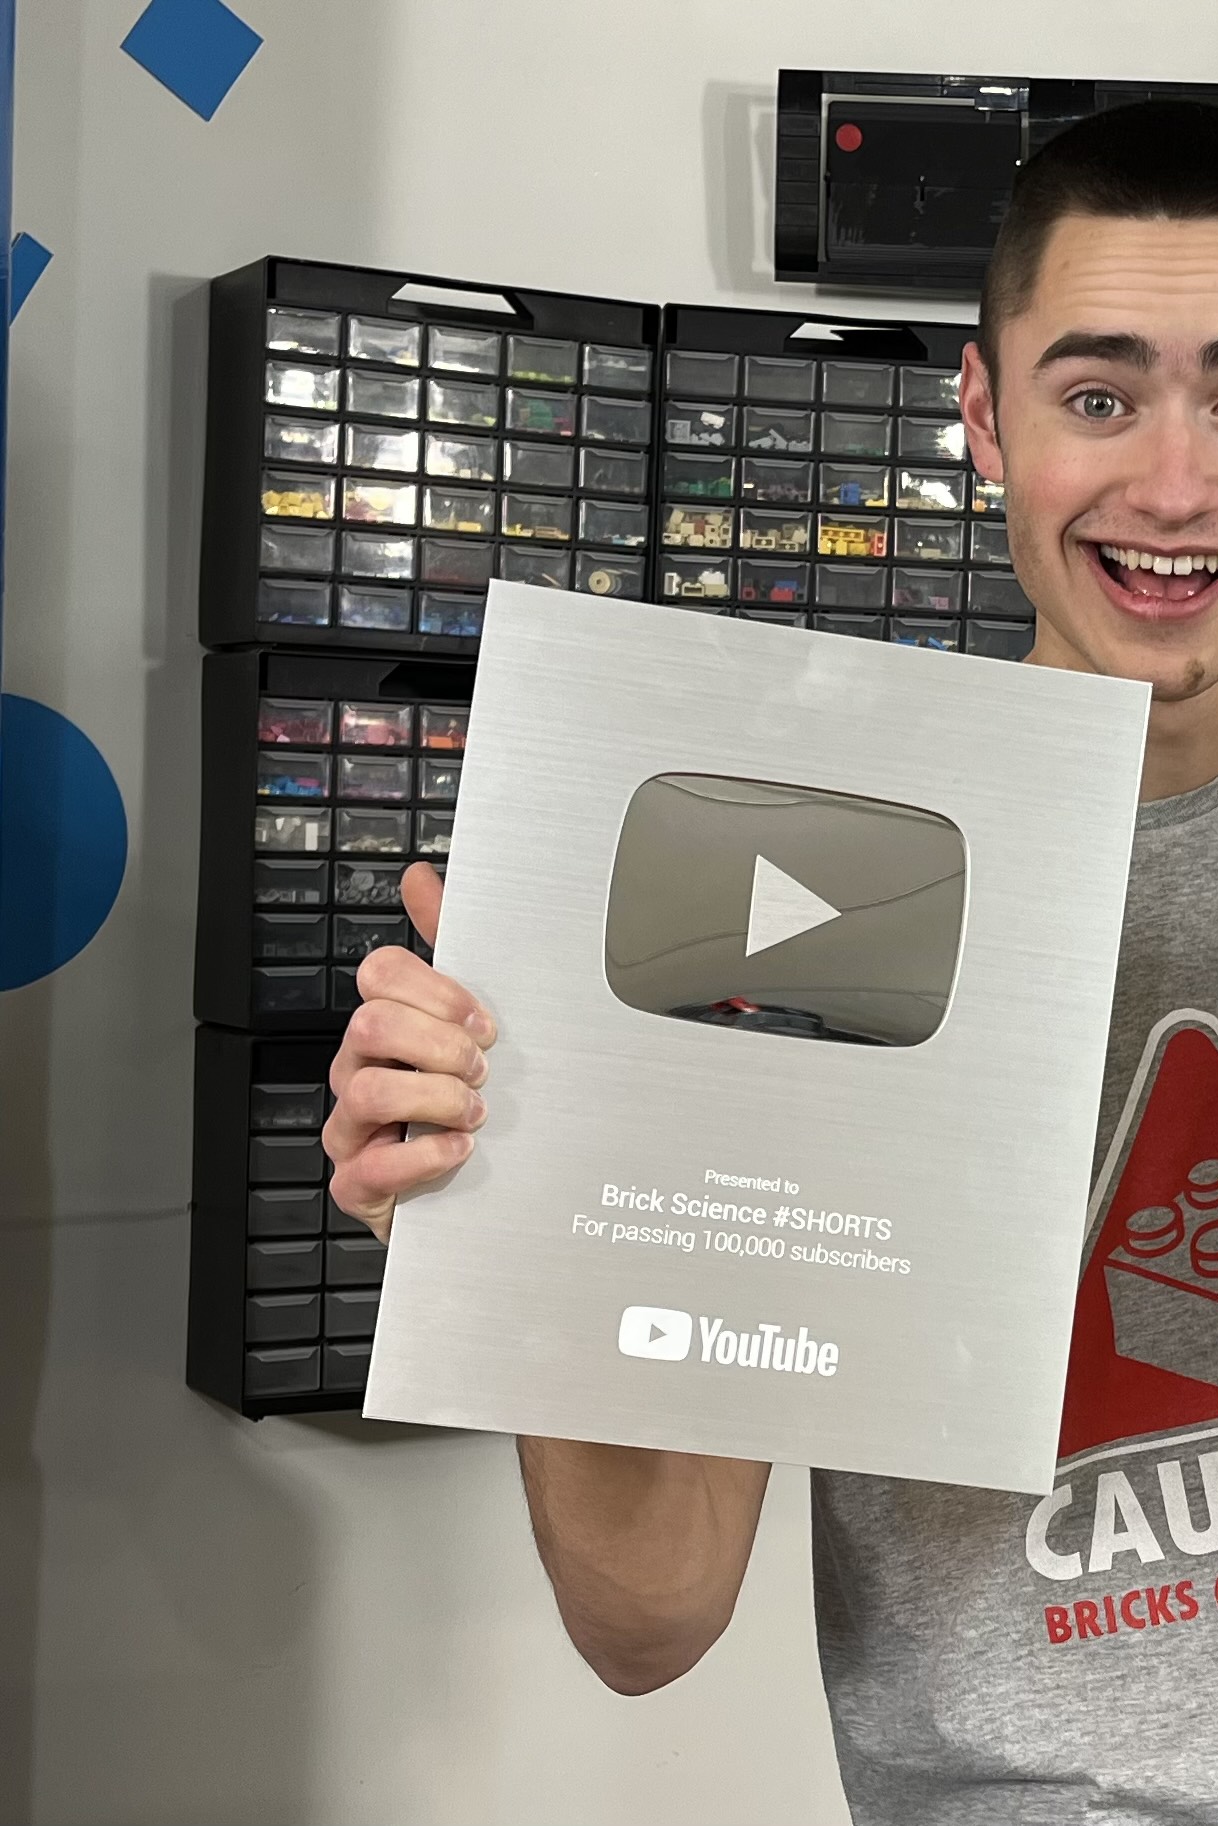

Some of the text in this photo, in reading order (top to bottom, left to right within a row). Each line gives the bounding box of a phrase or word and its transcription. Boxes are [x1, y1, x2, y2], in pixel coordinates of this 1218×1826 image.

[602, 1184, 893, 1240] Brick Science #SHORTS
[704, 1169, 800, 1195] Presented to
[571, 1214, 912, 1275] For passing 100,000 subscribers
[699, 1316, 840, 1377] YouTube
[1044, 1580, 1199, 1644] BRICKS
